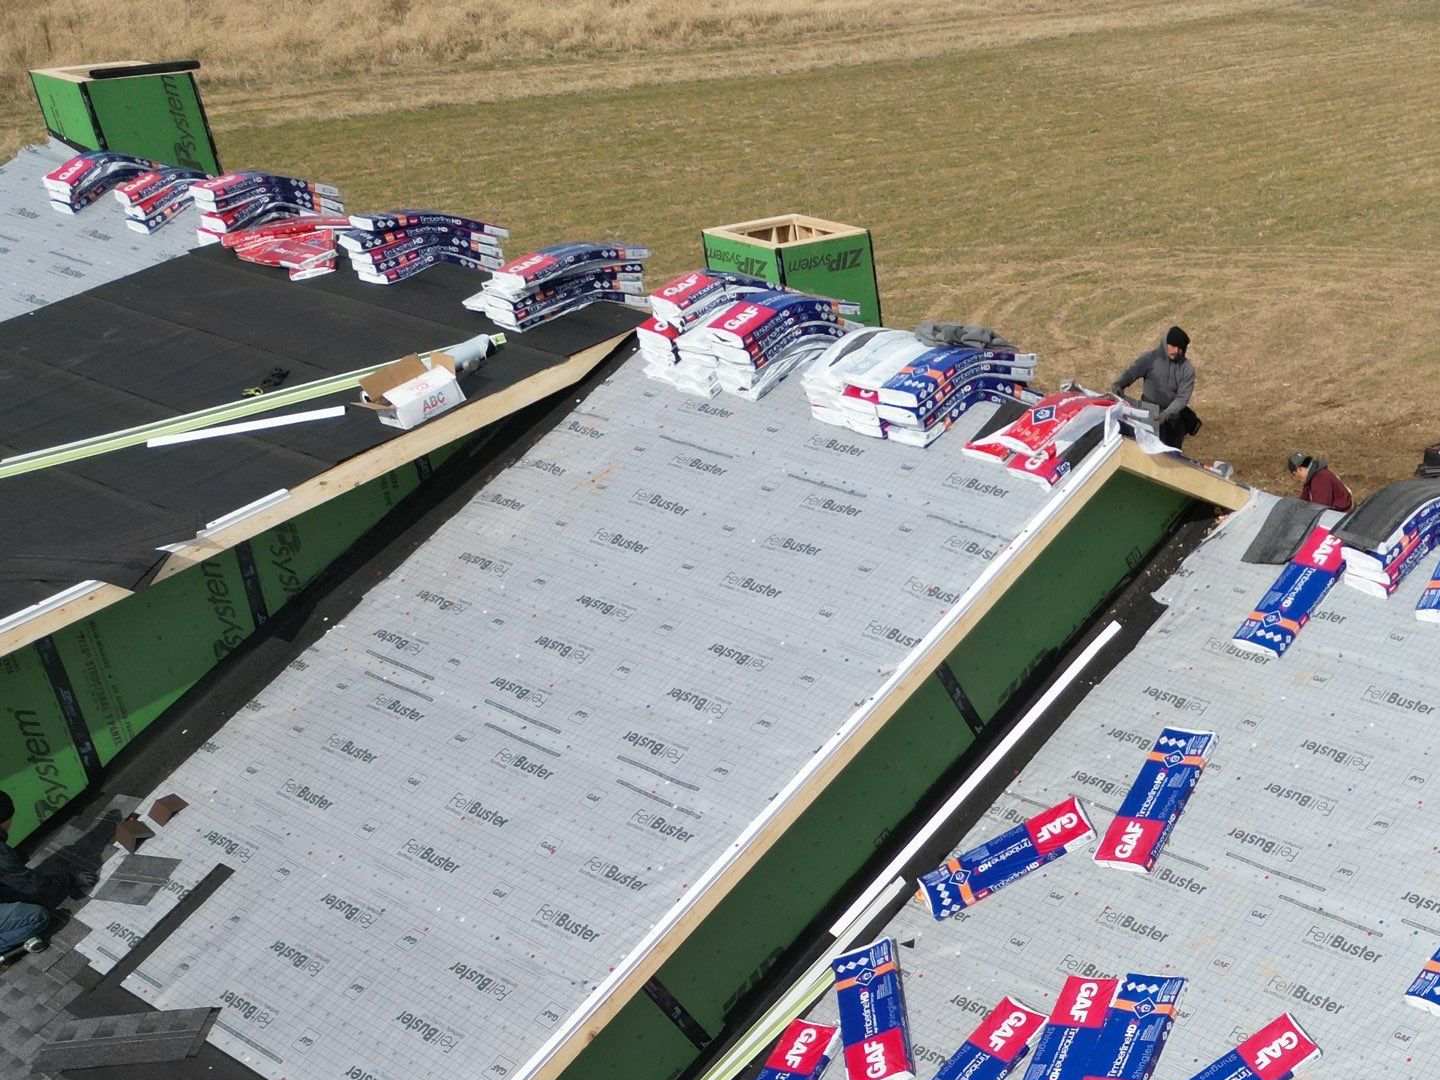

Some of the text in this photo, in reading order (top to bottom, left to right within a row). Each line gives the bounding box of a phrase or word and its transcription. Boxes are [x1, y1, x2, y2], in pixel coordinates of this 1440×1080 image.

[161, 74, 203, 169] Psystem
[58, 159, 84, 180] GAF
[123, 173, 153, 191] GAF
[203, 174, 235, 188] GAF
[510, 255, 544, 274] GAF
[789, 248, 864, 272] ZIPsystem
[663, 274, 698, 296] GAF
[724, 306, 759, 330] GAF
[422, 391, 445, 412] ABC
[682, 399, 734, 419] FeltBuster
[946, 472, 1009, 499] FeltBuster
[459, 552, 509, 577] FeltBuster
[1311, 534, 1338, 565] GAF
[708, 642, 770, 671] FeltBuster
[1143, 685, 1208, 716] FeltBuster
[326, 733, 377, 764] FeltBuster
[1300, 738, 1371, 772] FeltBuster
[15, 710, 68, 823] Psystem
[1135, 771, 1165, 819] TimberlineHD
[1036, 812, 1078, 843] GAF
[1114, 821, 1144, 859] GAF
[204, 830, 256, 863] FeltBuster
[978, 838, 1033, 873] TimberlineHD
[585, 857, 647, 892] FeltBuster
[1100, 906, 1168, 944] FeltBuster
[1306, 926, 1383, 963] FeltBuster
[219, 990, 275, 1030] FeltBuster
[860, 990, 873, 1039] TimberlineHD
[1070, 982, 1098, 1023] GAF
[396, 1010, 459, 1054] FeltBuster
[784, 1028, 817, 1069] GAF
[989, 1011, 1027, 1052] GAF
[866, 1041, 887, 1078] GAF
[1049, 1027, 1079, 1080] TimberlineHD
[1108, 1023, 1137, 1078] TimberlineHD
[1254, 1031, 1298, 1071] GAF
